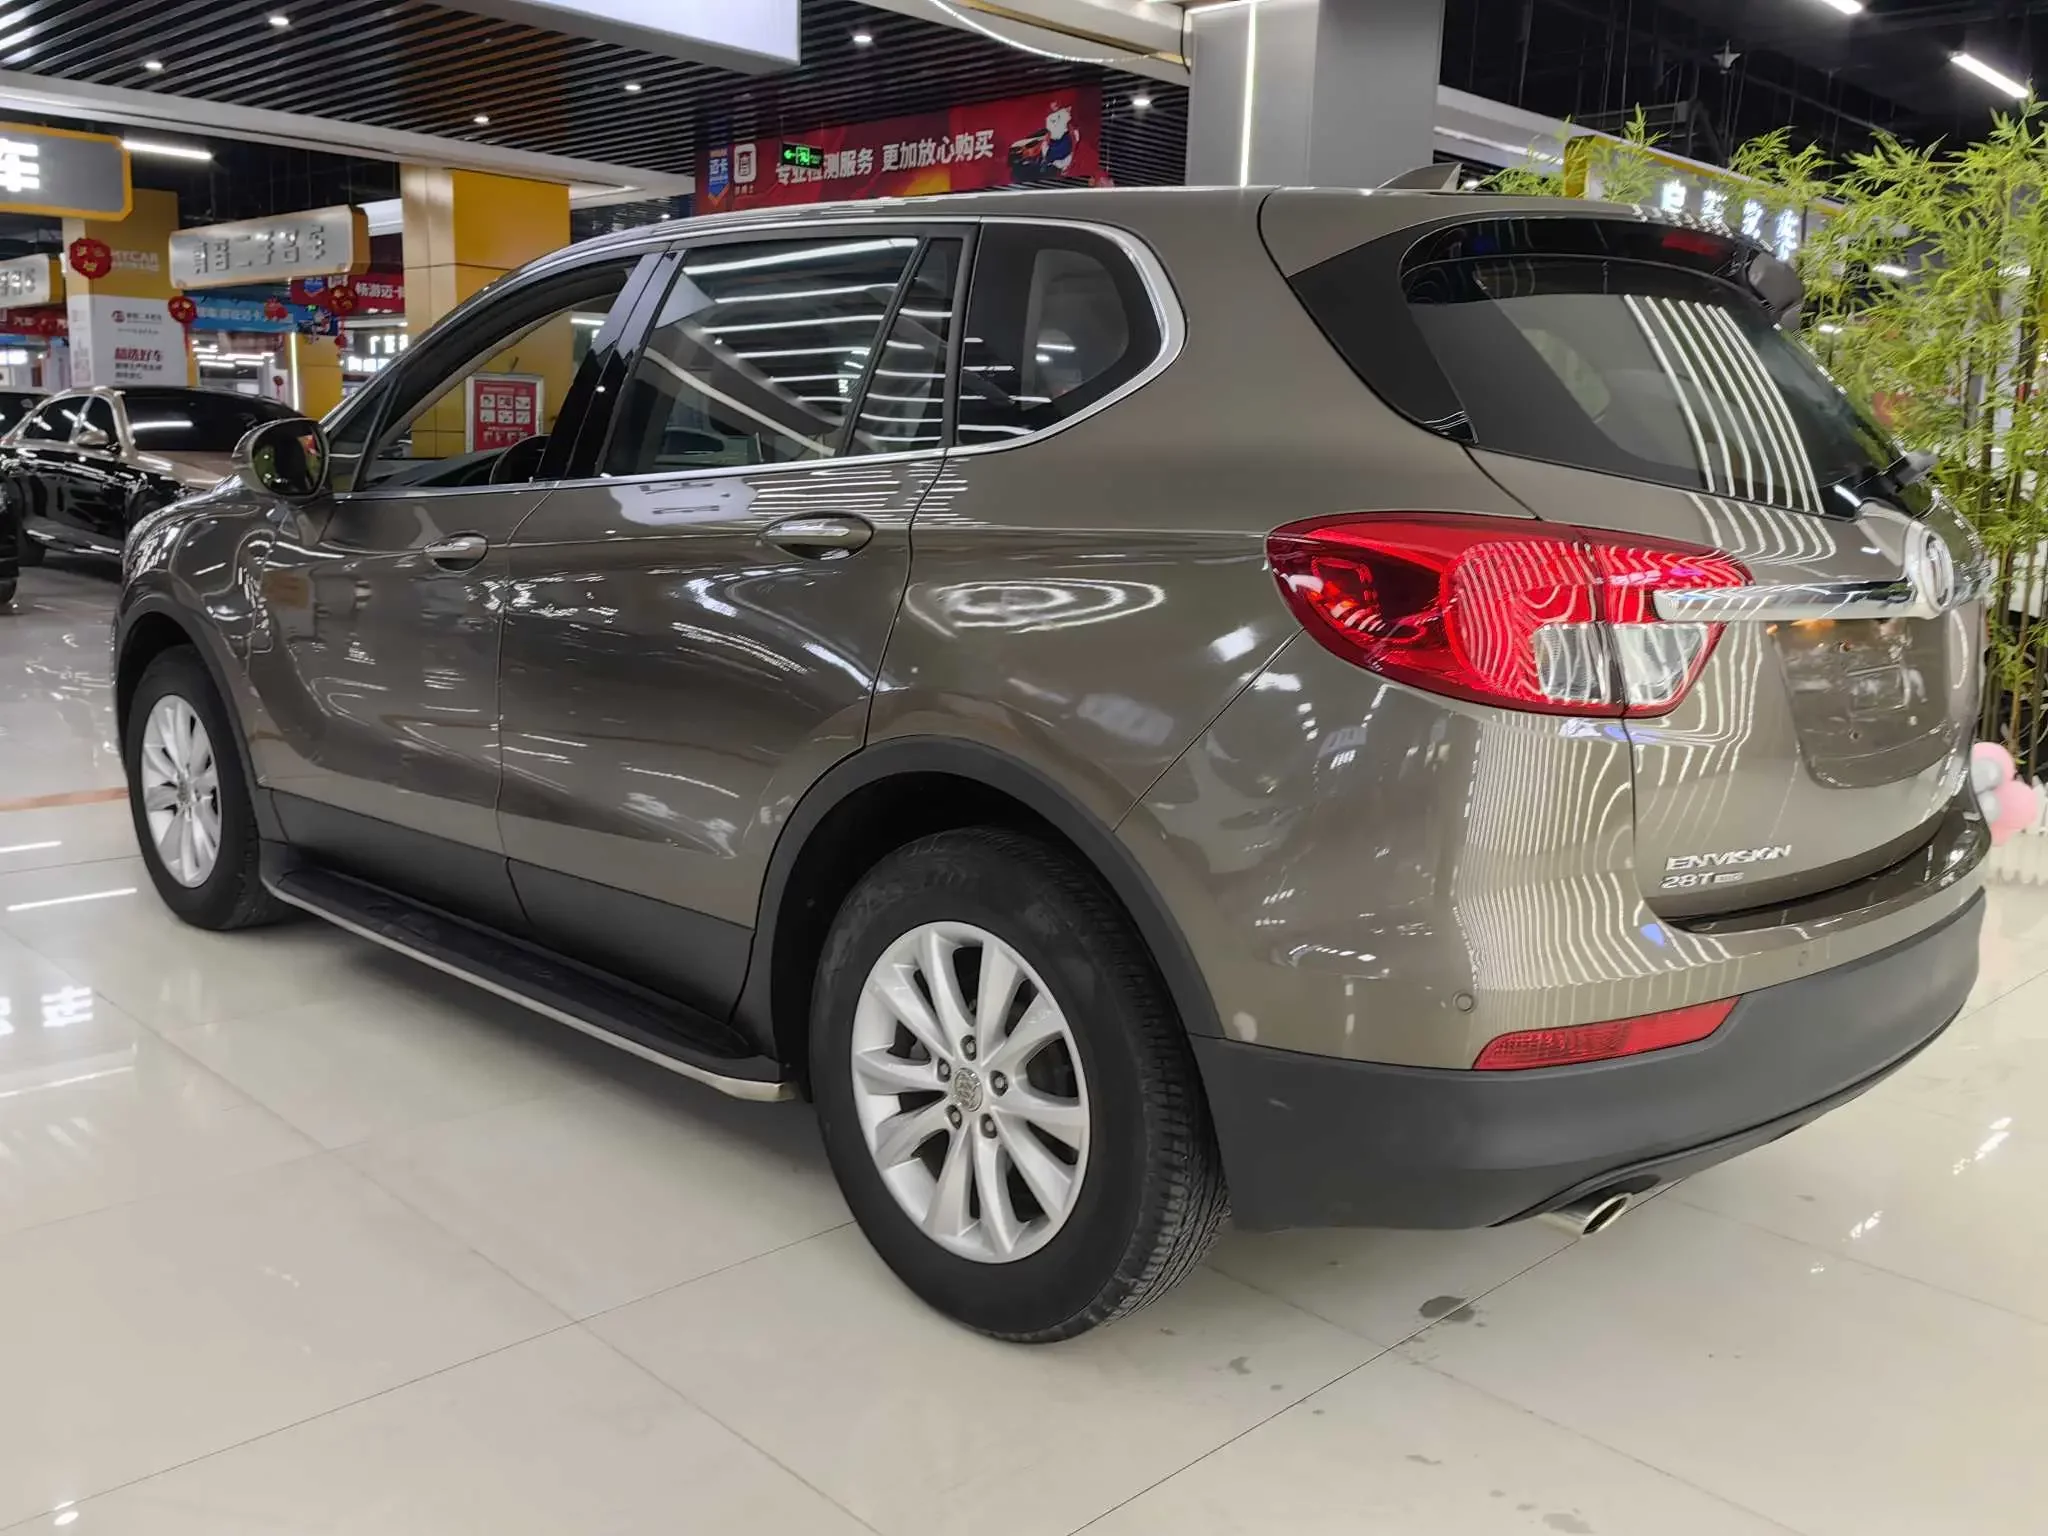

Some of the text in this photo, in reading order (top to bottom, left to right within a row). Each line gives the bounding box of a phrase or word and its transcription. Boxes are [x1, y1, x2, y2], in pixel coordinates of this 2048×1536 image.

[881, 129, 994, 171] 更加放心购买
[1664, 844, 1793, 871] ENVISION
[1660, 871, 1715, 889] 28T
